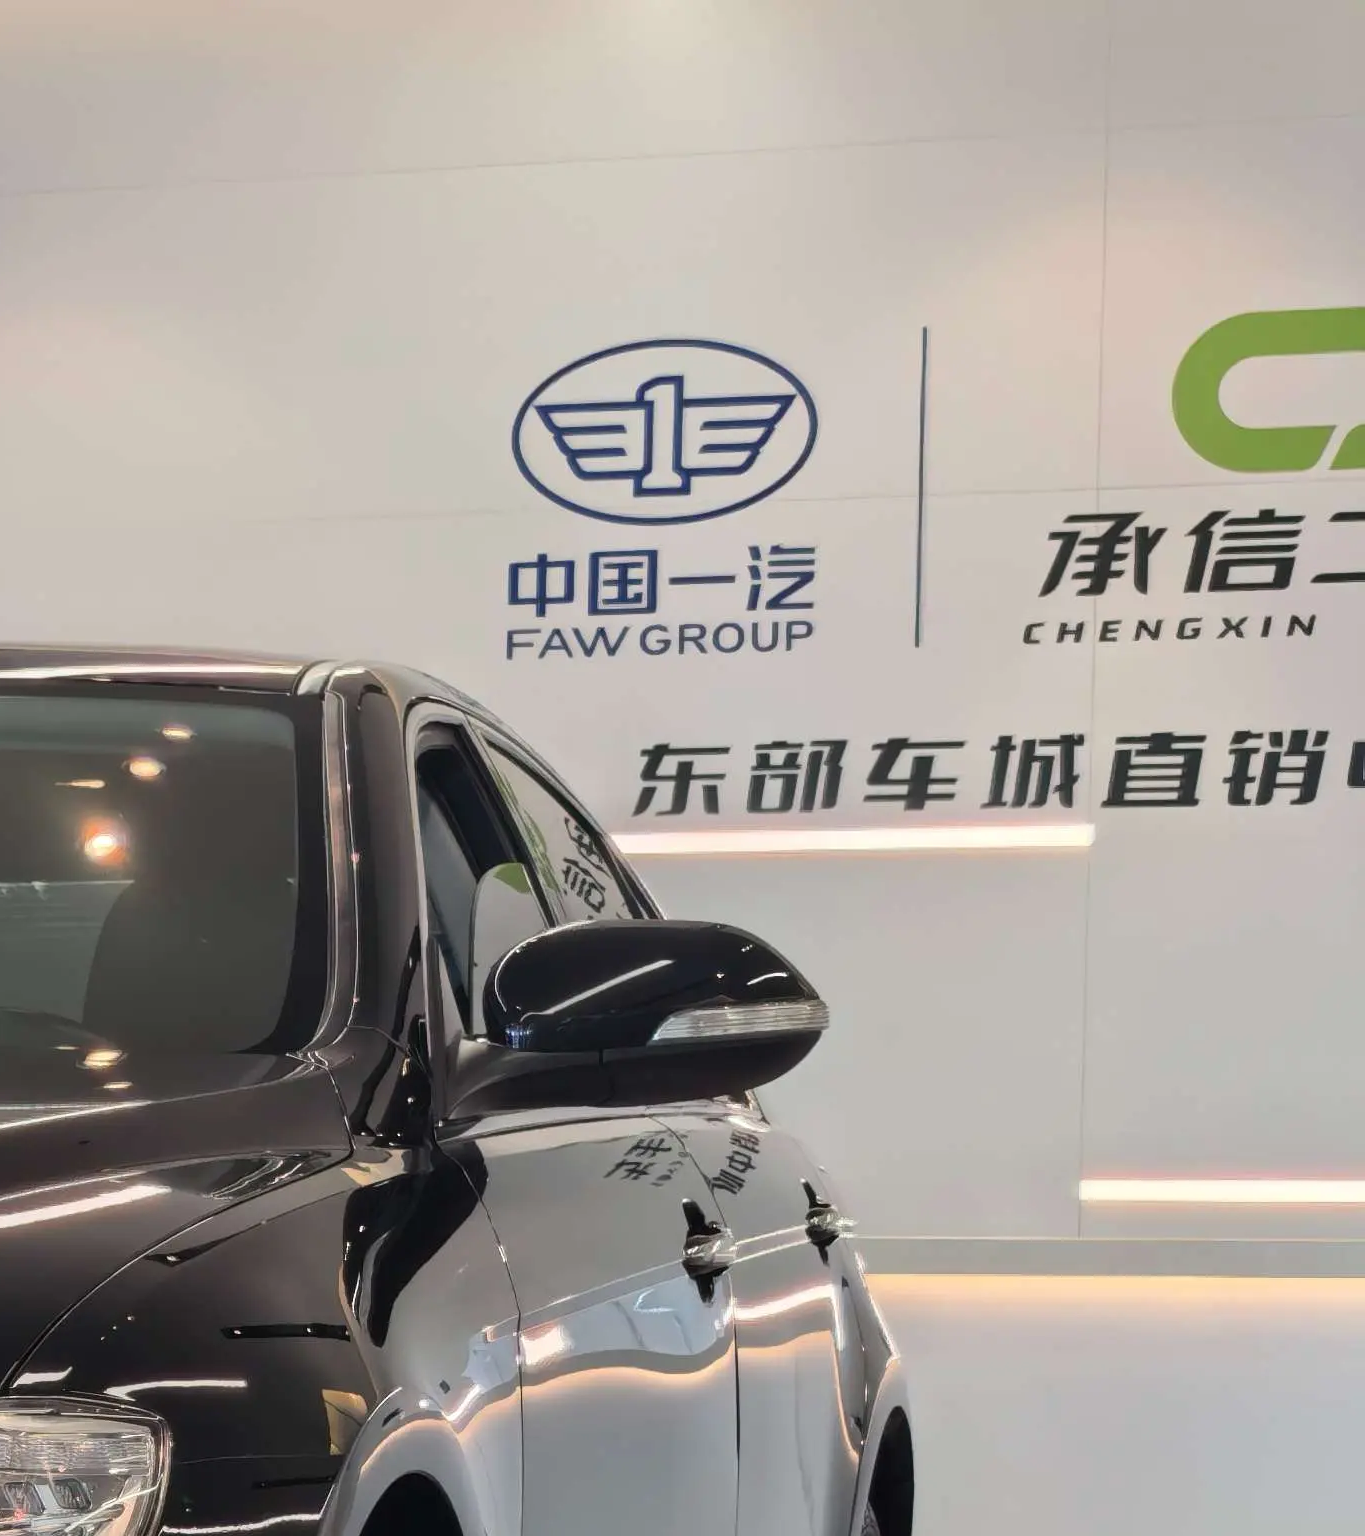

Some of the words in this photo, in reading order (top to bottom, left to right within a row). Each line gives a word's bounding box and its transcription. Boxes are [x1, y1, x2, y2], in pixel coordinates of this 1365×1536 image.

[507, 544, 817, 618] 中国一汽
[1022, 613, 1317, 645] CHENGXIN
[631, 728, 1365, 817] 东部车城直销
